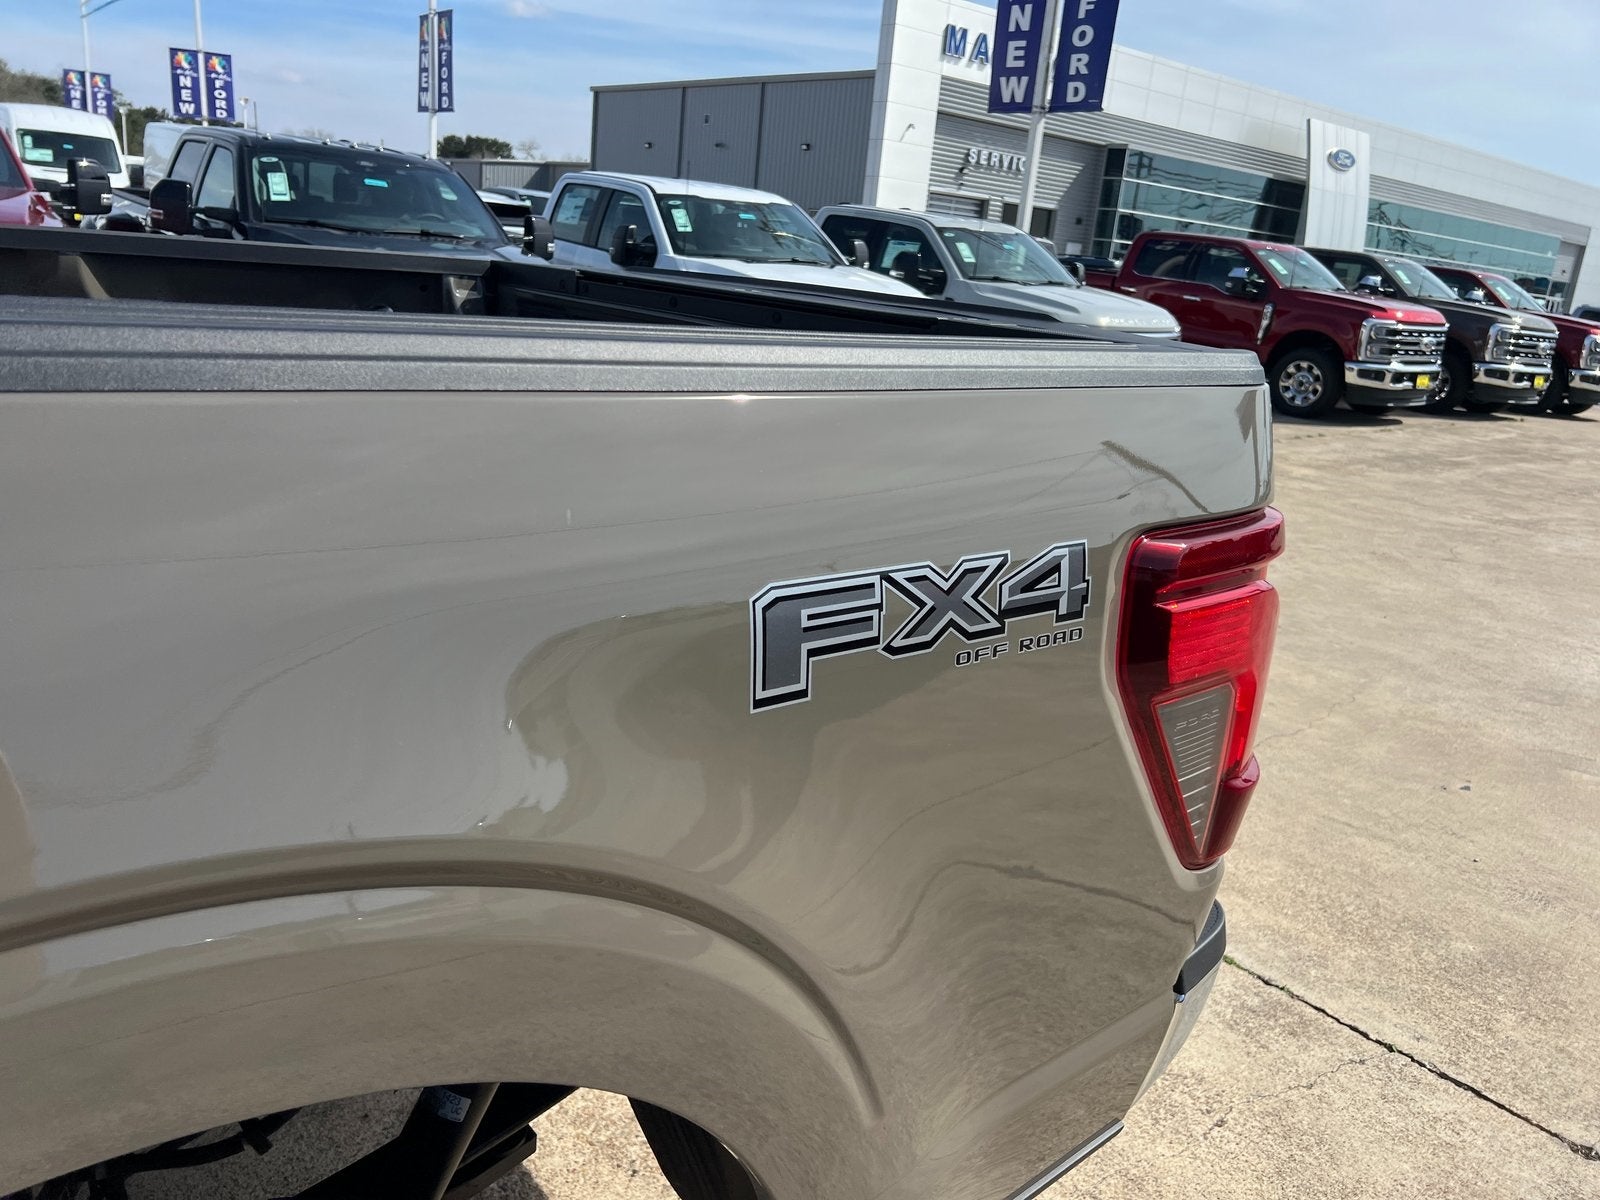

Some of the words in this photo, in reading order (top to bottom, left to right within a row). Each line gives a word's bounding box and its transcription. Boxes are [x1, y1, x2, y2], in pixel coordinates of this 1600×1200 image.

[1000, 3, 1033, 104] NEW
[1066, 0, 1097, 103] FORD
[178, 75, 195, 115] NEW
[214, 80, 228, 119] FORD
[419, 52, 429, 108] NEW
[440, 53, 449, 109] FORD
[749, 539, 1092, 714] FX4
[955, 642, 1009, 667] OFF
[1017, 626, 1084, 654] ROAD
